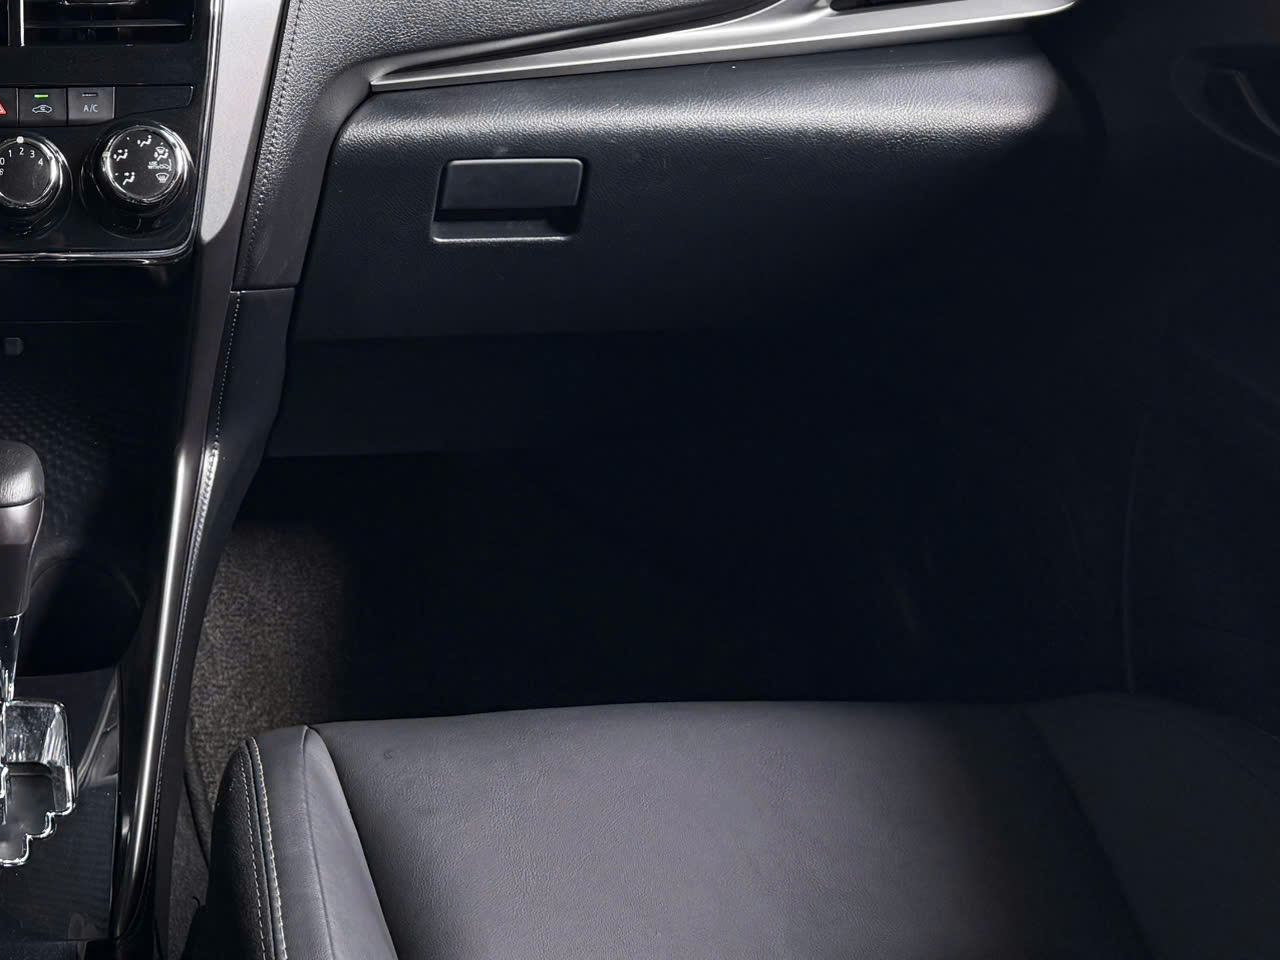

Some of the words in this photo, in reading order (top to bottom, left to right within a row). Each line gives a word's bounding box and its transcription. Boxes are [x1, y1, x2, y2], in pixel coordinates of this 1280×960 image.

[83, 104, 98, 113] A/C
[8, 150, 12, 158] 1
[19, 147, 24, 156] 2
[30, 150, 35, 158] 3
[0, 157, 5, 166] 0
[38, 158, 44, 166] 4
